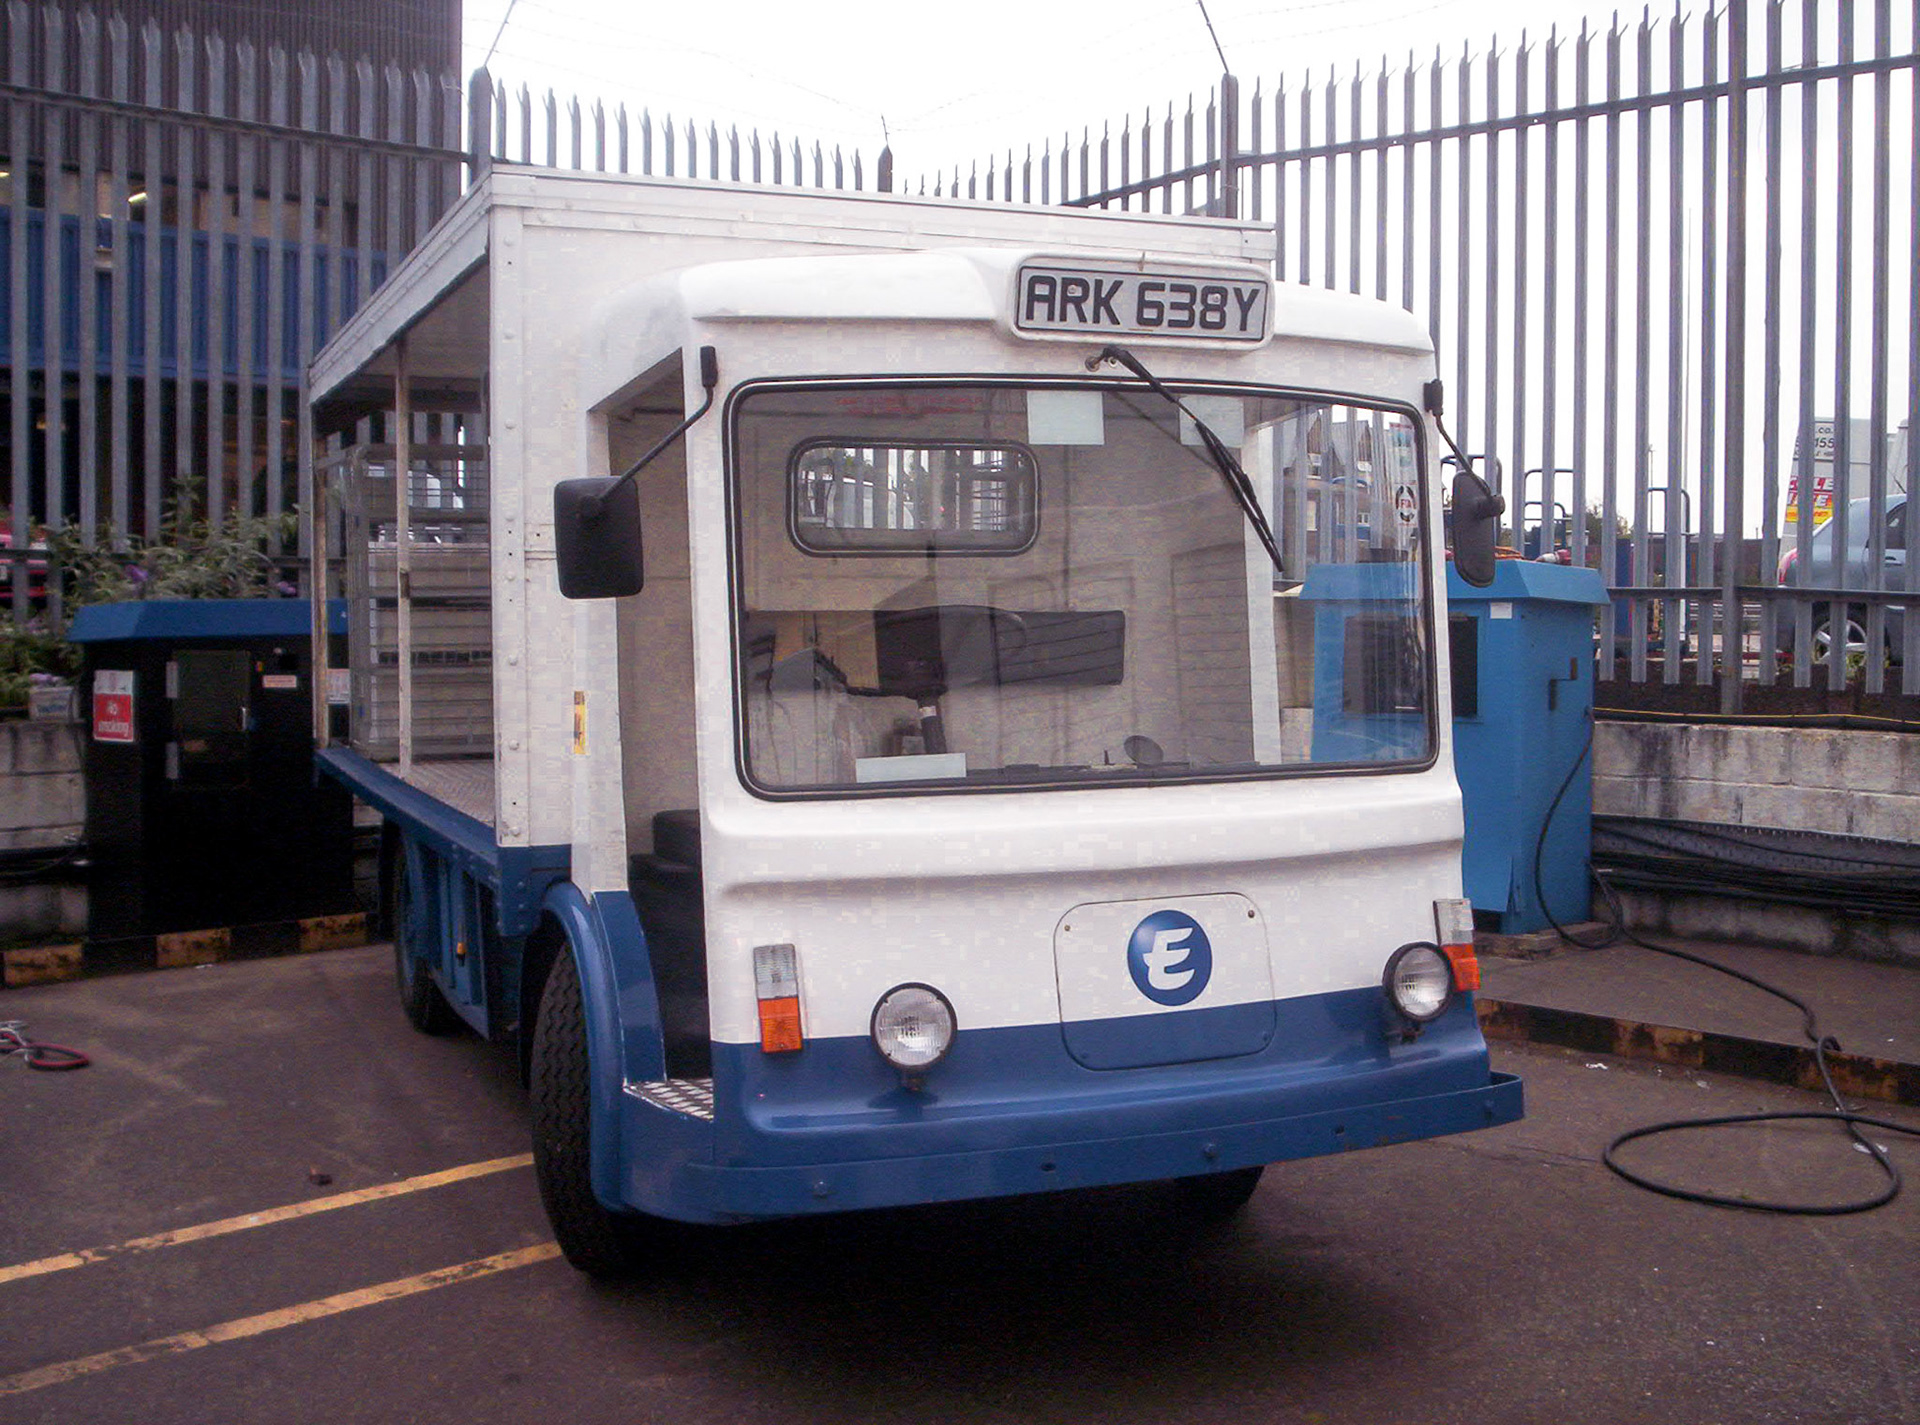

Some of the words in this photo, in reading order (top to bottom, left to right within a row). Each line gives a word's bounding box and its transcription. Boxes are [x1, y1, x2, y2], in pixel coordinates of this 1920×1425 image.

[1026, 275, 1124, 325] ARK
[1136, 282, 1260, 331] 638Y
[1143, 927, 1195, 991] E
